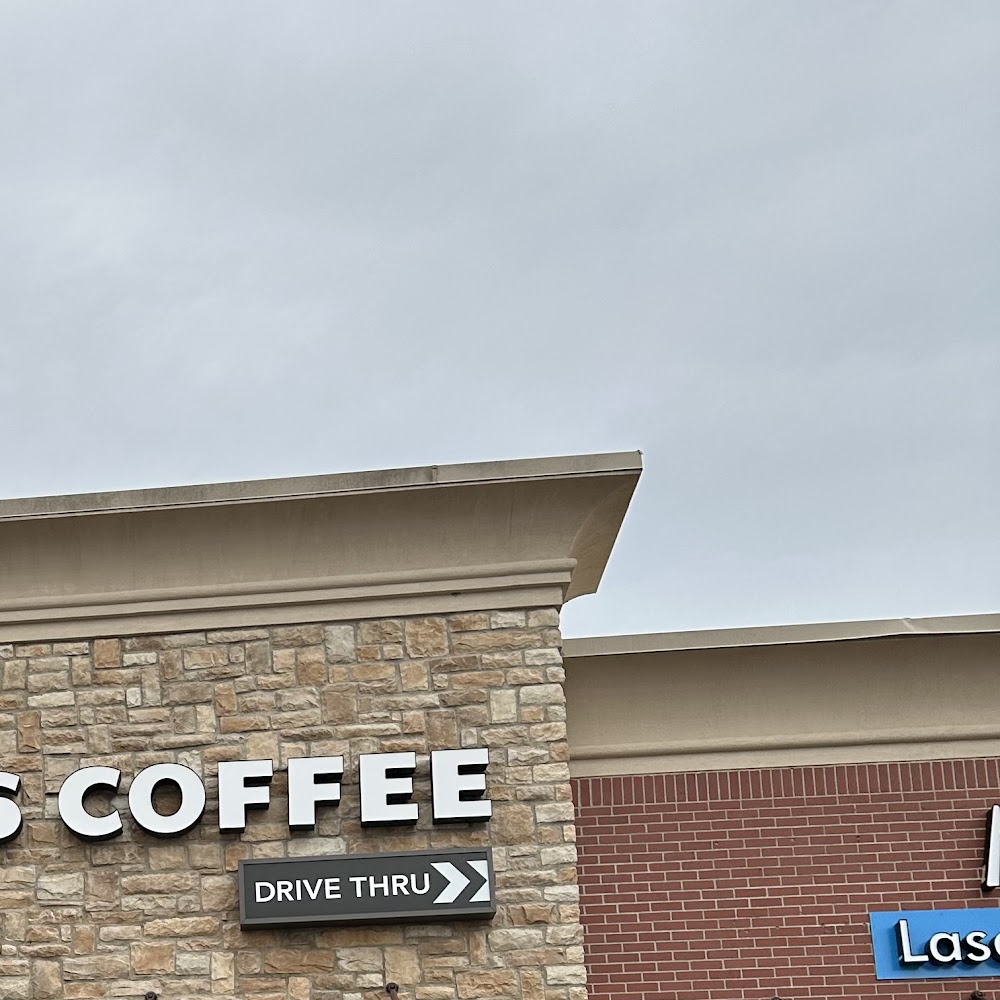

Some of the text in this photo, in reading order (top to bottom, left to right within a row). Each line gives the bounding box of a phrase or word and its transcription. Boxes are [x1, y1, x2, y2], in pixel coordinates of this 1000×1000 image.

[57, 748, 492, 842] COFFEE
[254, 872, 431, 903] DRIVE THRU
[896, 918, 1000, 965] Las
